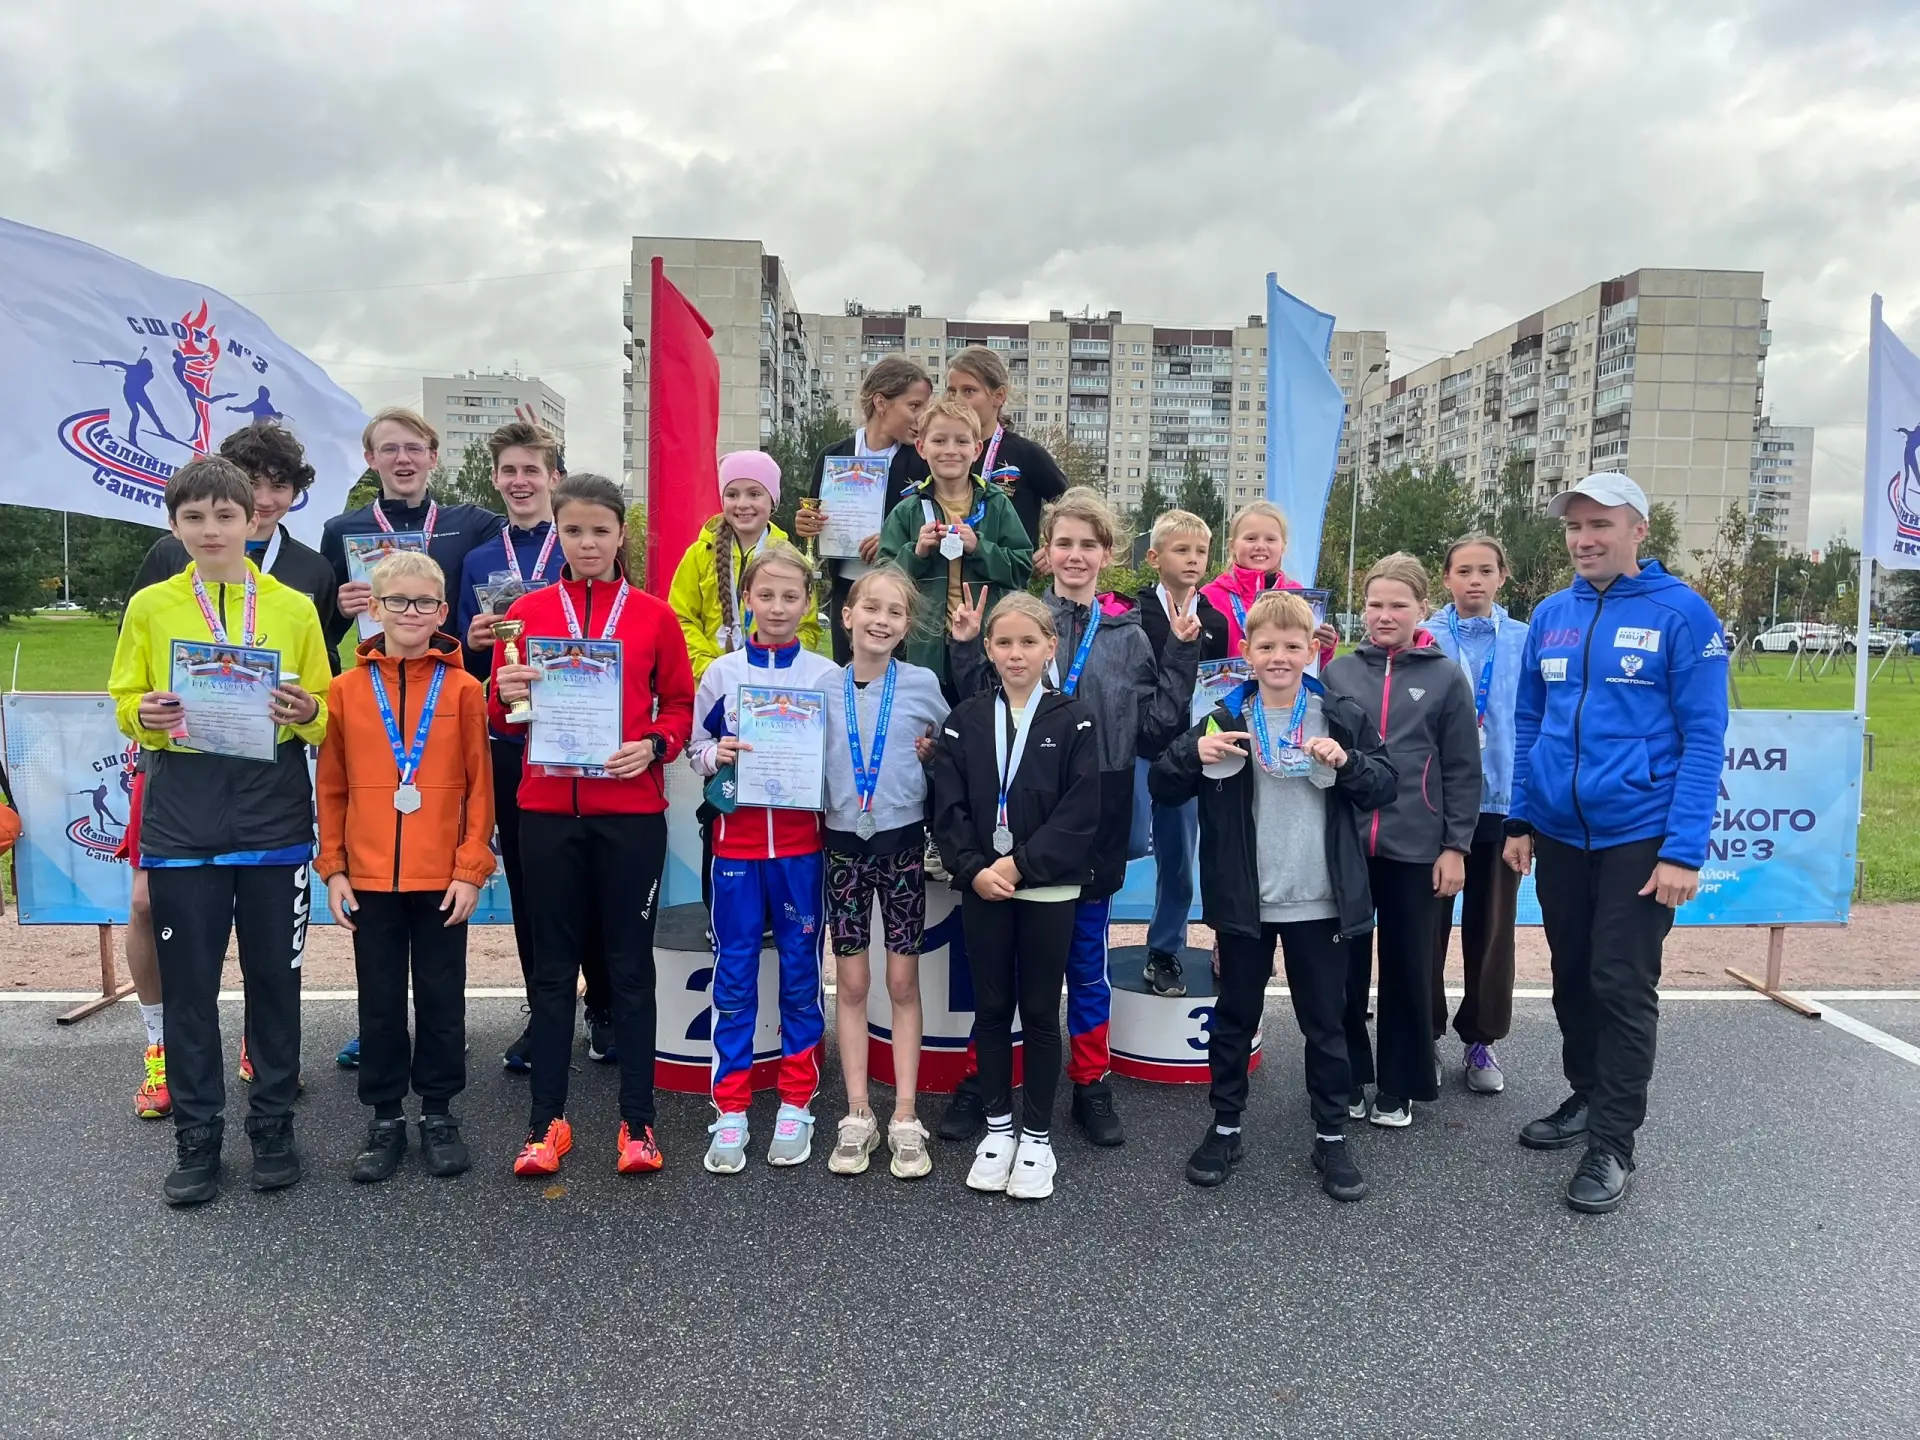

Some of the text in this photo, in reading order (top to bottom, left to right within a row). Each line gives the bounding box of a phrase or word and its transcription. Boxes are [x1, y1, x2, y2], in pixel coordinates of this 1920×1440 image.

[126, 316, 211, 343] СШОР
[1542, 628, 1580, 649] RUS
[191, 679, 256, 692] ГРАМОТА
[1186, 1006, 1216, 1050] 3
